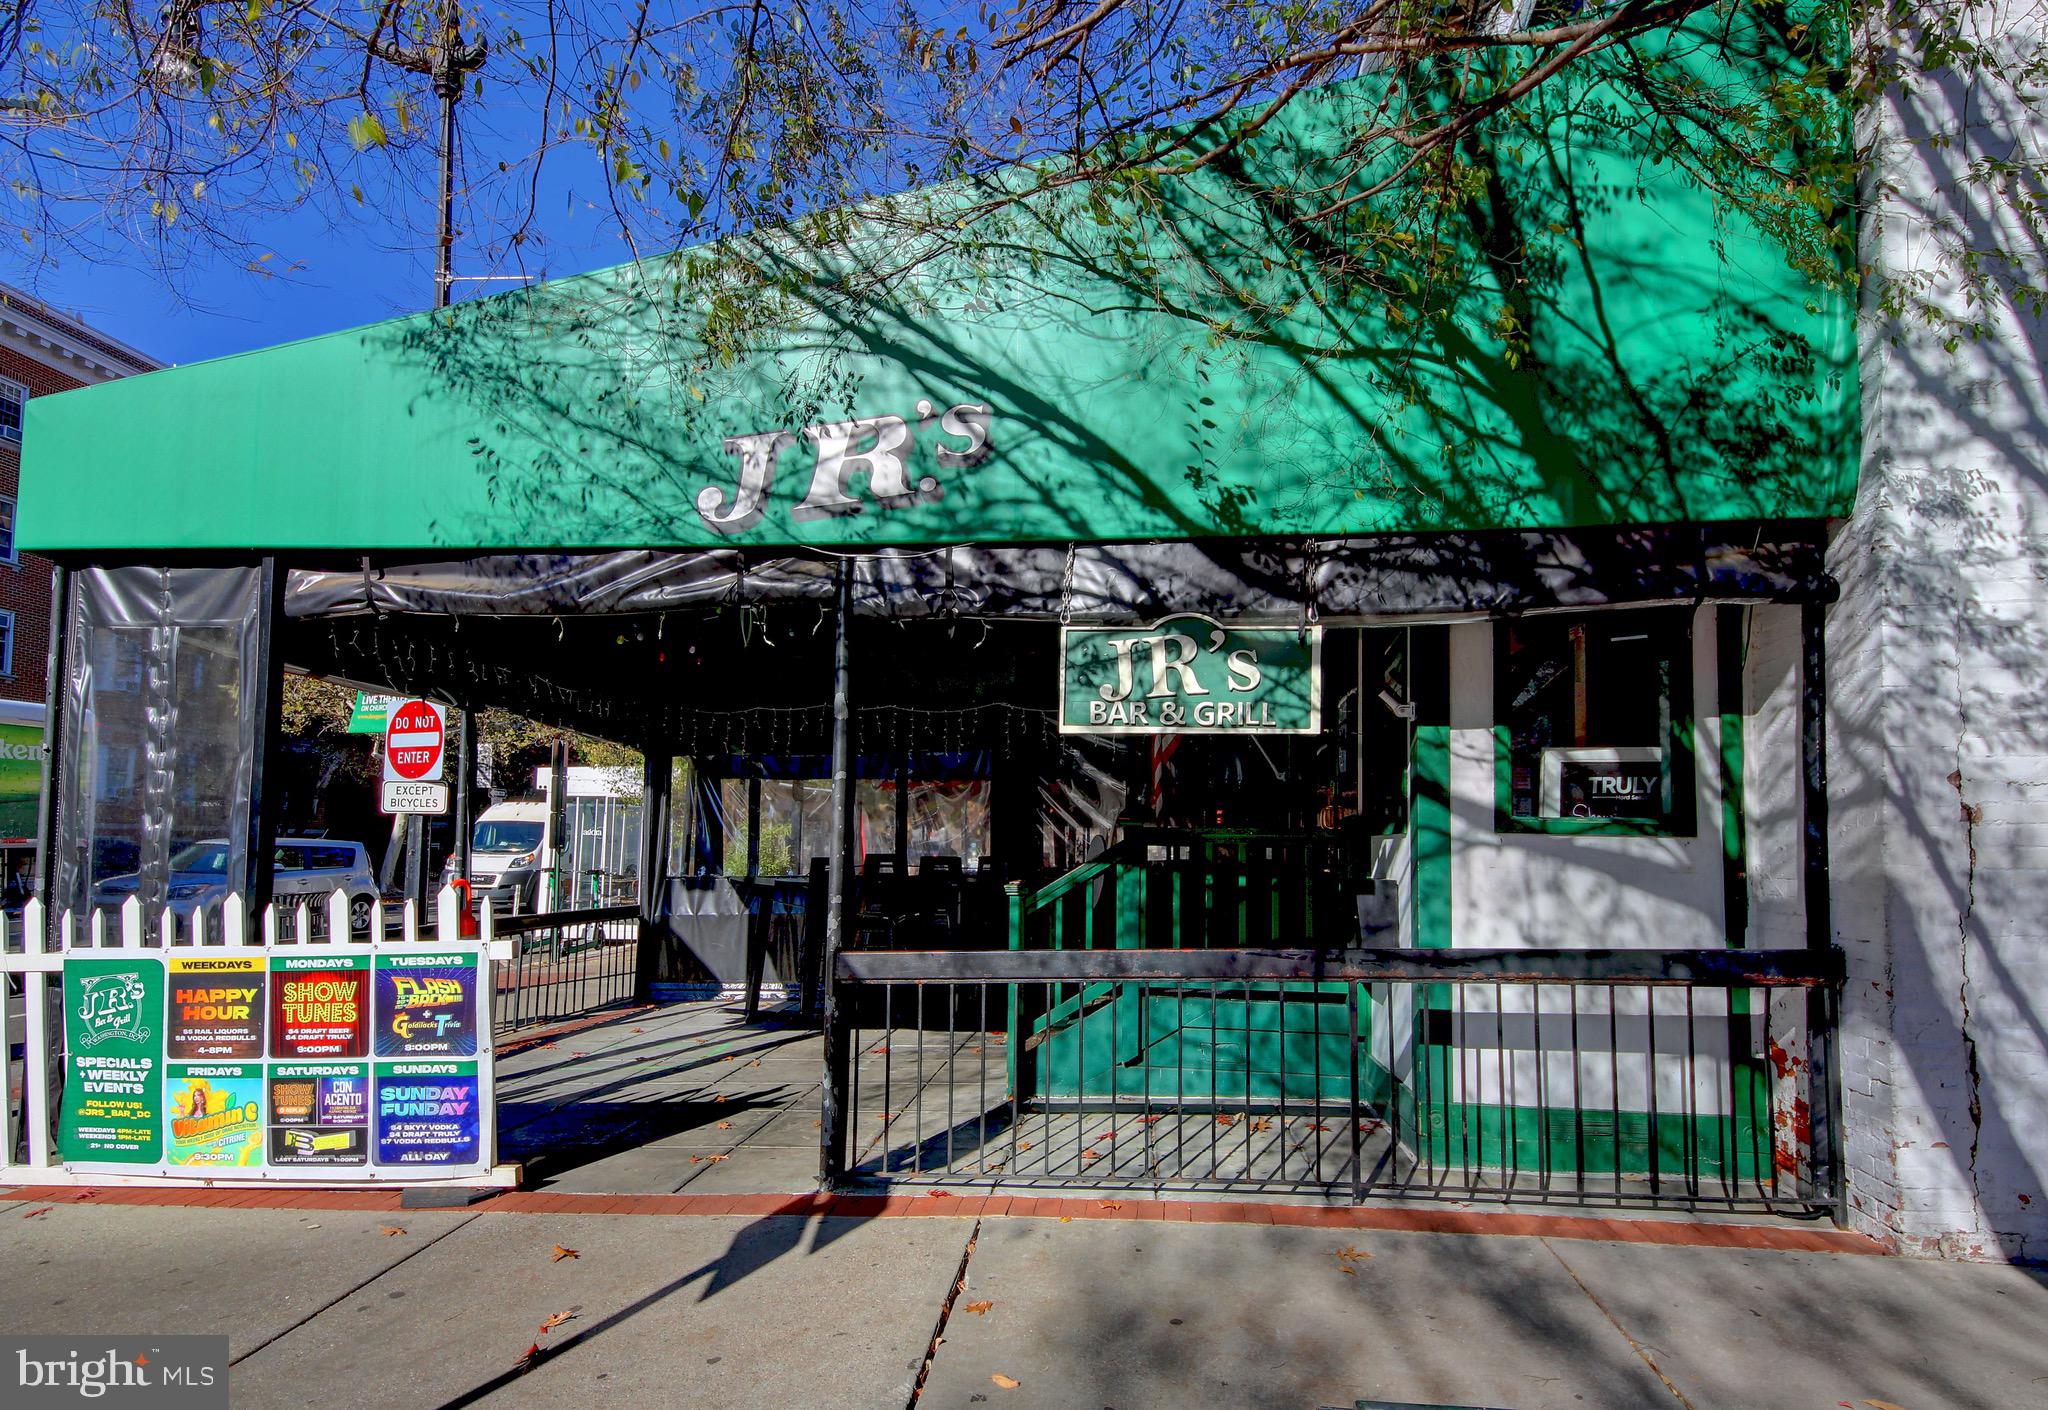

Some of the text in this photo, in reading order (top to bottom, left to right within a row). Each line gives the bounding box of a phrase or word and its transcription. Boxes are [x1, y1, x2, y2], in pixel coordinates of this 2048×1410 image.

[1100, 630, 1261, 701] JR's
[362, 695, 378, 704] LIVE
[1089, 701, 1276, 726] BAR & GRILL
[395, 716, 435, 729] DO NOT
[397, 751, 430, 764] ENTER
[396, 786, 434, 795] EXCEPT
[1588, 776, 1658, 794] TRULY
[390, 798, 438, 808] BICYCLES
[181, 960, 252, 969] WEEKDAYS
[285, 958, 354, 969] MONDAYS
[389, 956, 464, 967] TUESDAYS
[284, 981, 358, 1002] SHOW
[391, 976, 463, 995] FLASH
[176, 988, 258, 1003] HAPPY
[405, 994, 448, 1009] BACK
[183, 1005, 250, 1020] HOUR
[282, 1002, 358, 1023] TUNES
[392, 1014, 461, 1038] Goldilocks Trivia
[76, 1056, 153, 1069] SPECIALS
[86, 1069, 149, 1082] WEEKLY
[187, 1067, 242, 1076] FRIDAYS
[277, 1066, 360, 1076] SATURDAYS
[393, 1065, 458, 1074] SUNDAYS
[84, 1081, 144, 1094] EVENTS
[273, 1084, 313, 1096] SHOW
[333, 1081, 353, 1093] CON
[380, 1086, 470, 1101] SUNDAY
[86, 1100, 143, 1109] FOLLOW US!
[273, 1095, 313, 1106] TUNES
[324, 1093, 362, 1106] ACENTO
[78, 1109, 151, 1119] @JRS_BAR_DC
[380, 1102, 470, 1116] FUNDAY
[172, 1101, 259, 1138] Vitamin C
[219, 1132, 246, 1147] CITRINE
[424, 1136, 470, 1144] REDBULLS
[400, 1151, 449, 1161] ALL DAY
